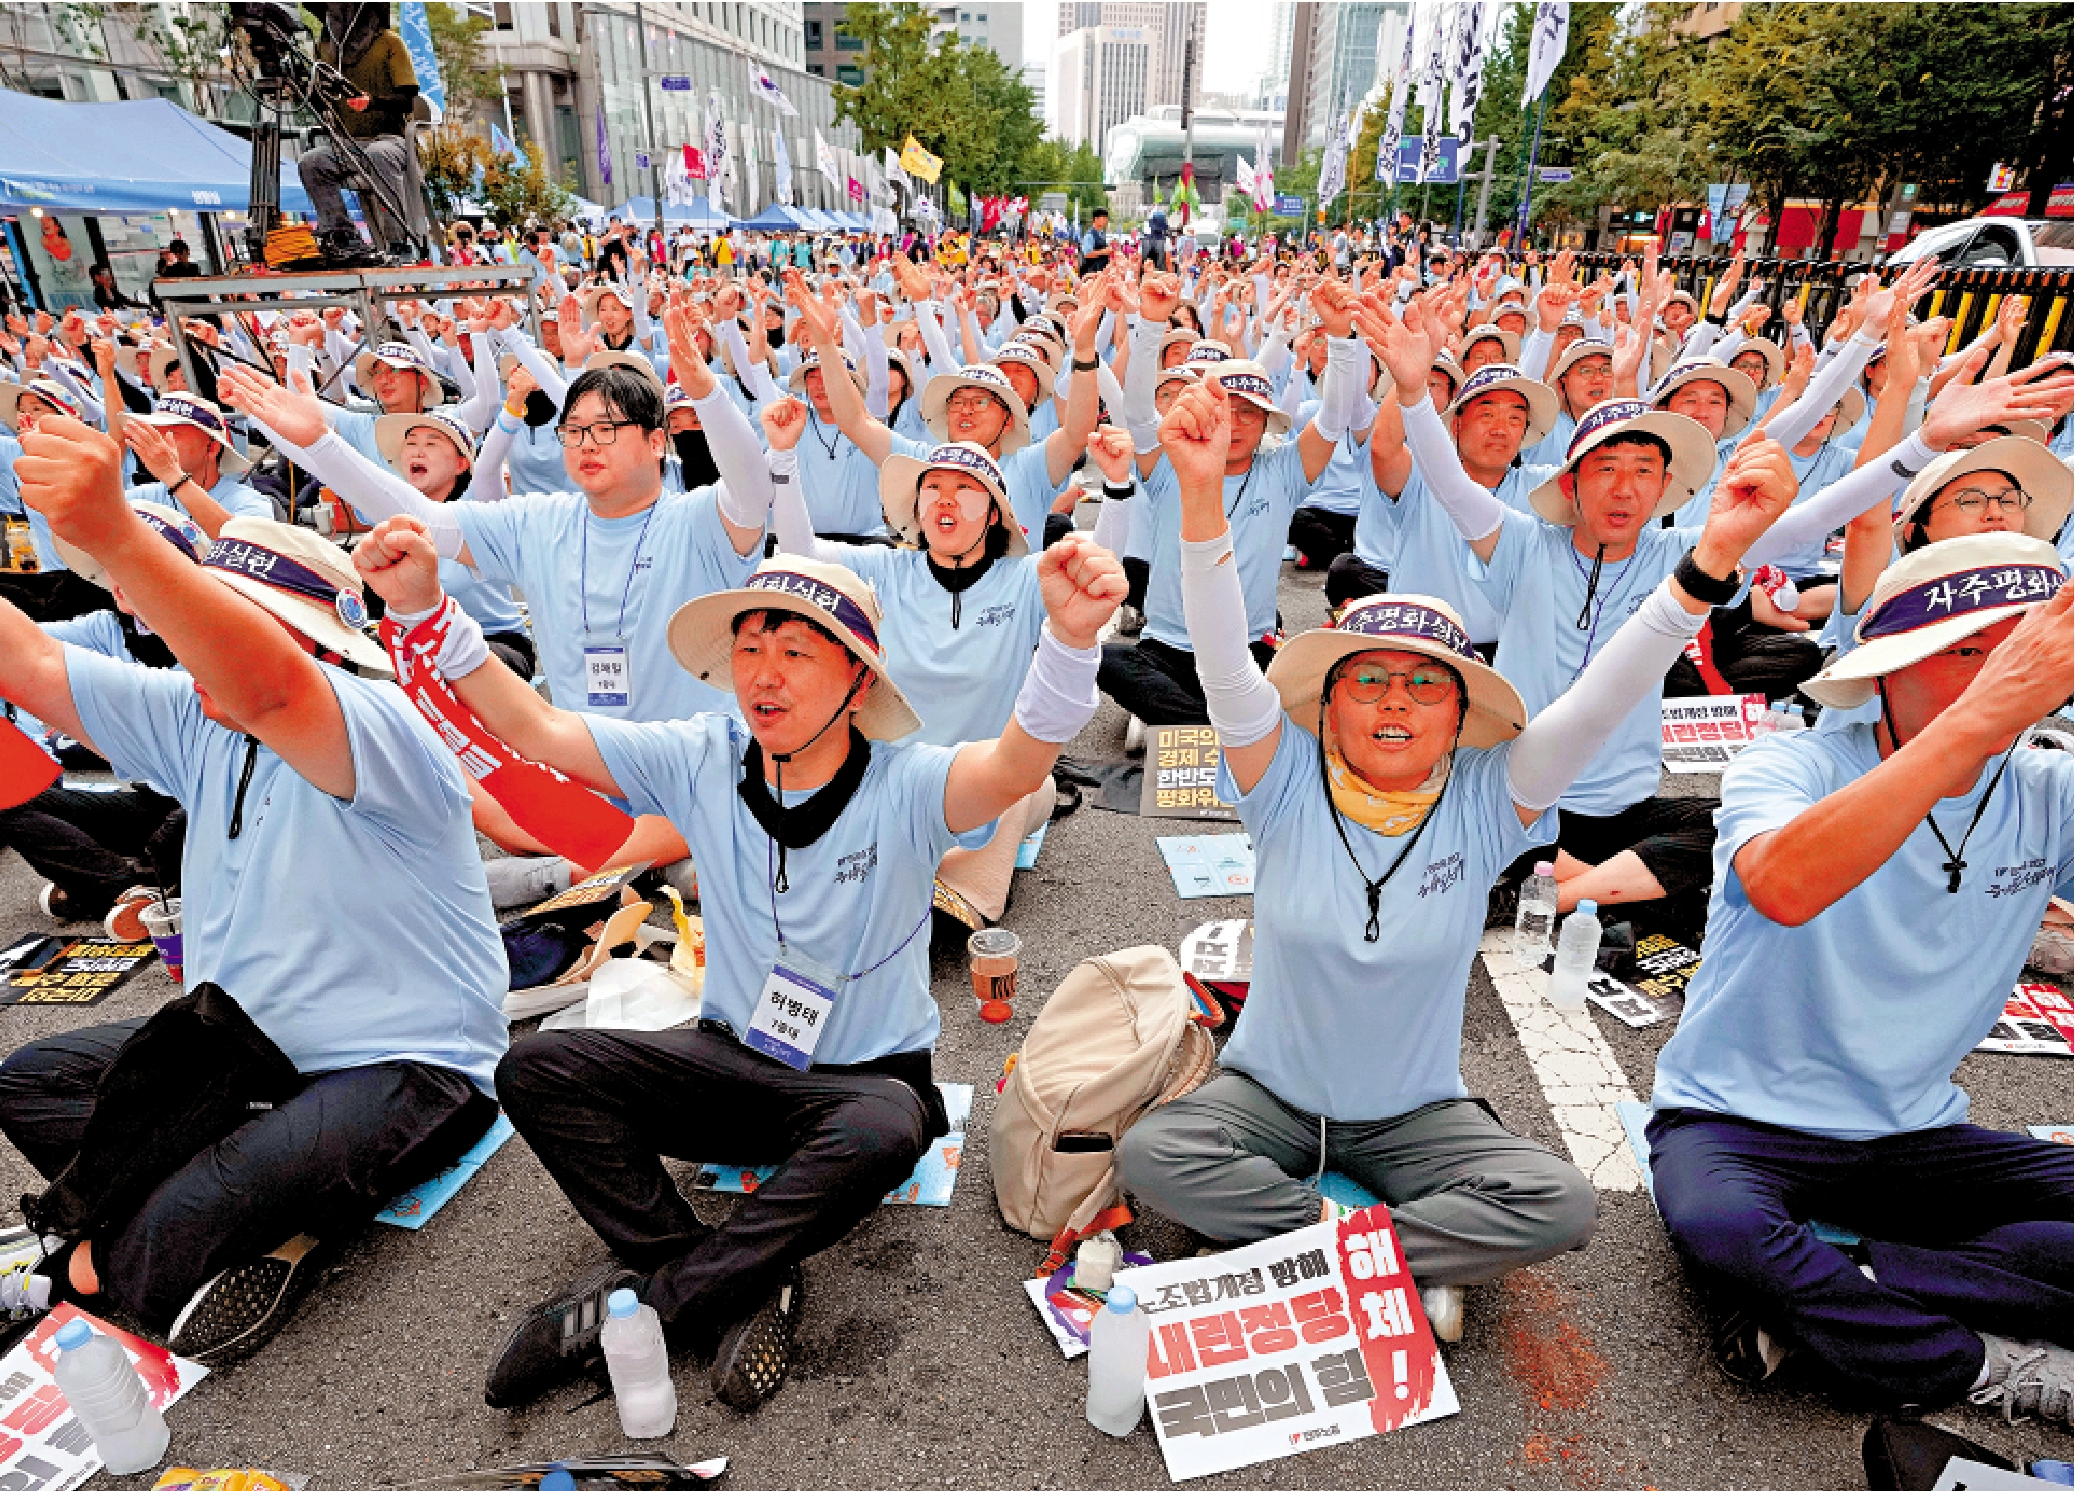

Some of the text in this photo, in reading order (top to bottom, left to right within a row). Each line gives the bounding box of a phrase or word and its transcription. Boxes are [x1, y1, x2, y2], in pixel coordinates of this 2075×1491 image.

[1158, 729, 1220, 749] 미국의
[1158, 748, 1199, 768] 경제
[1156, 767, 1217, 790] 한반도
[1156, 787, 1236, 809] 평화위
[1267, 1248, 1331, 1289] 방해
[1147, 1284, 1350, 1381] 내란정당
[1154, 1347, 1376, 1439] 국민의 힘
